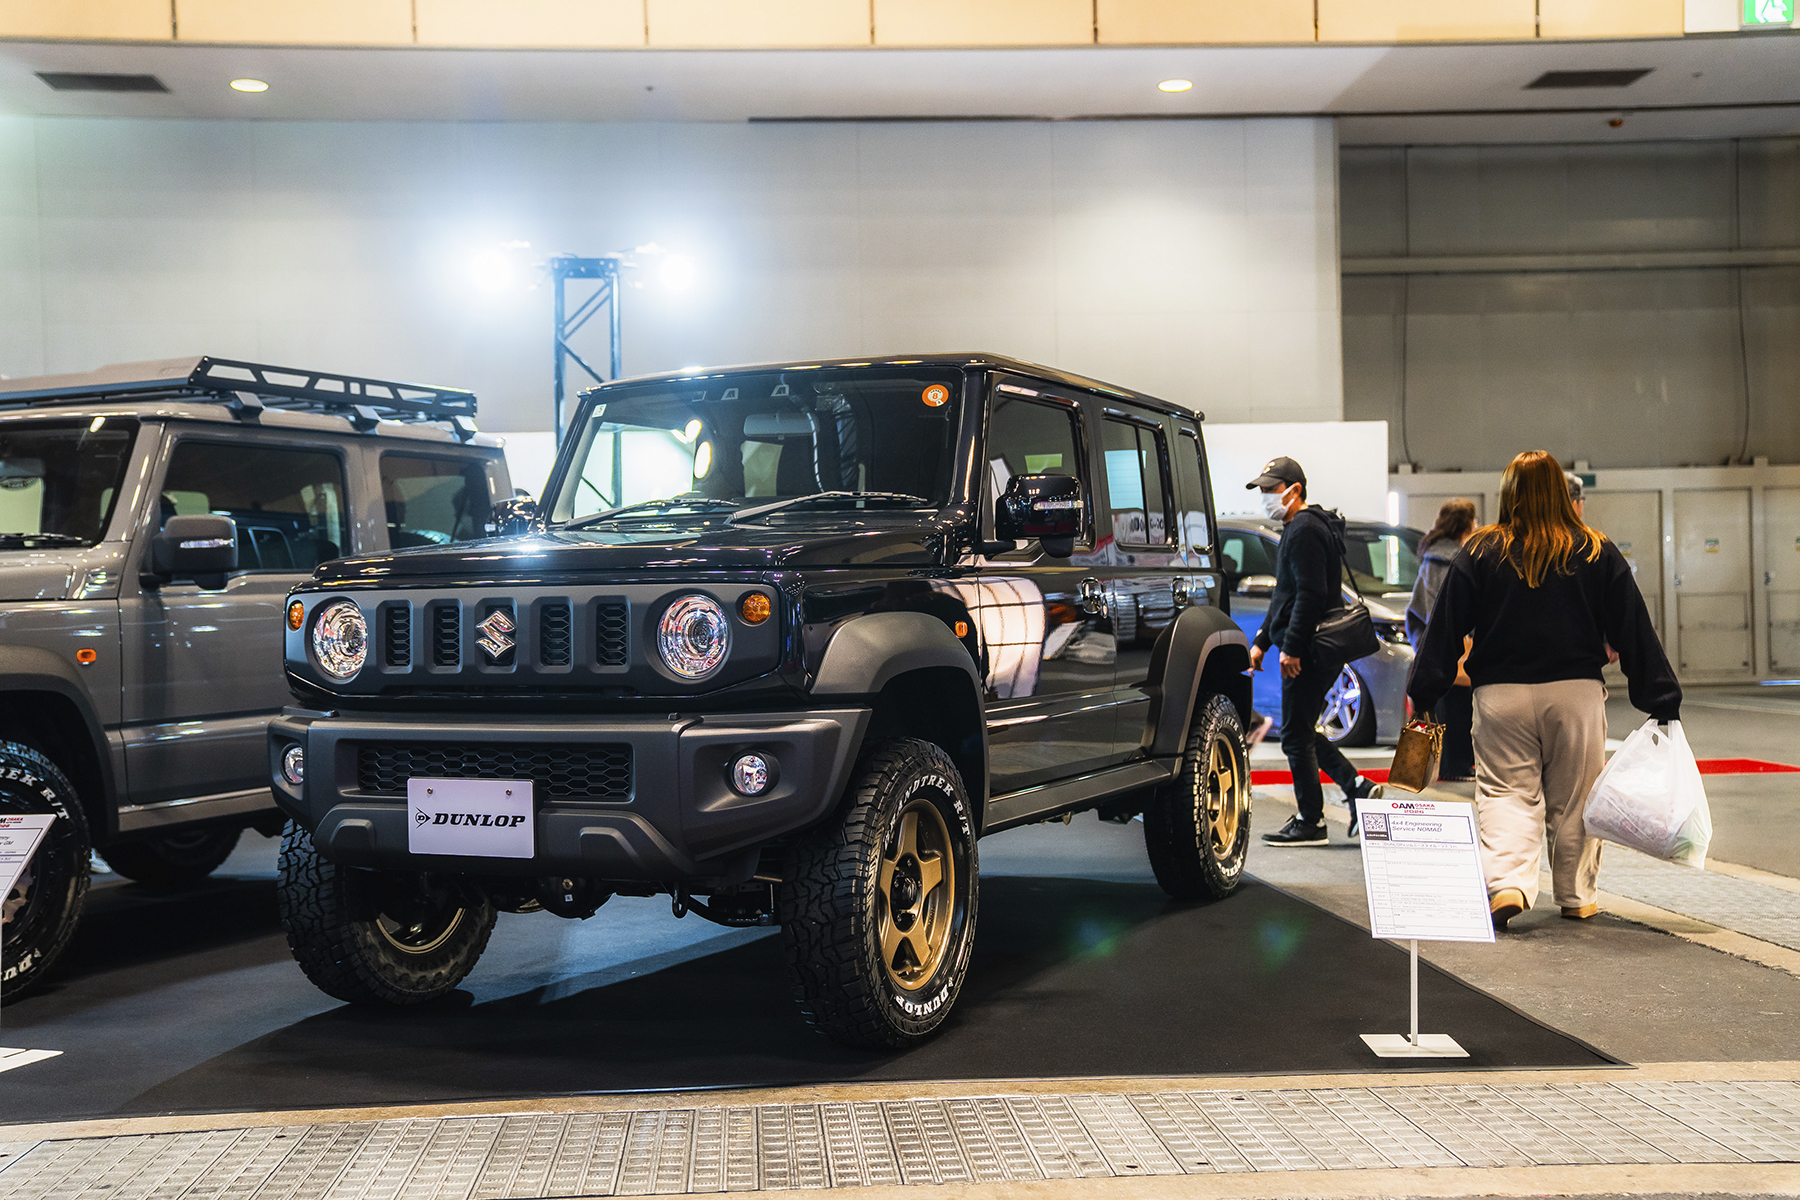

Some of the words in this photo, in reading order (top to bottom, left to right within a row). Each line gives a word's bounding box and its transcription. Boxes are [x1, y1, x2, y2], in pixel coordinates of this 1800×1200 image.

[40, 787, 70, 820] R/T
[953, 800, 970, 836] R/T
[1391, 802, 1415, 810] OAM
[432, 813, 526, 827] DUNLOP
[895, 984, 949, 1016] DUNLOP
